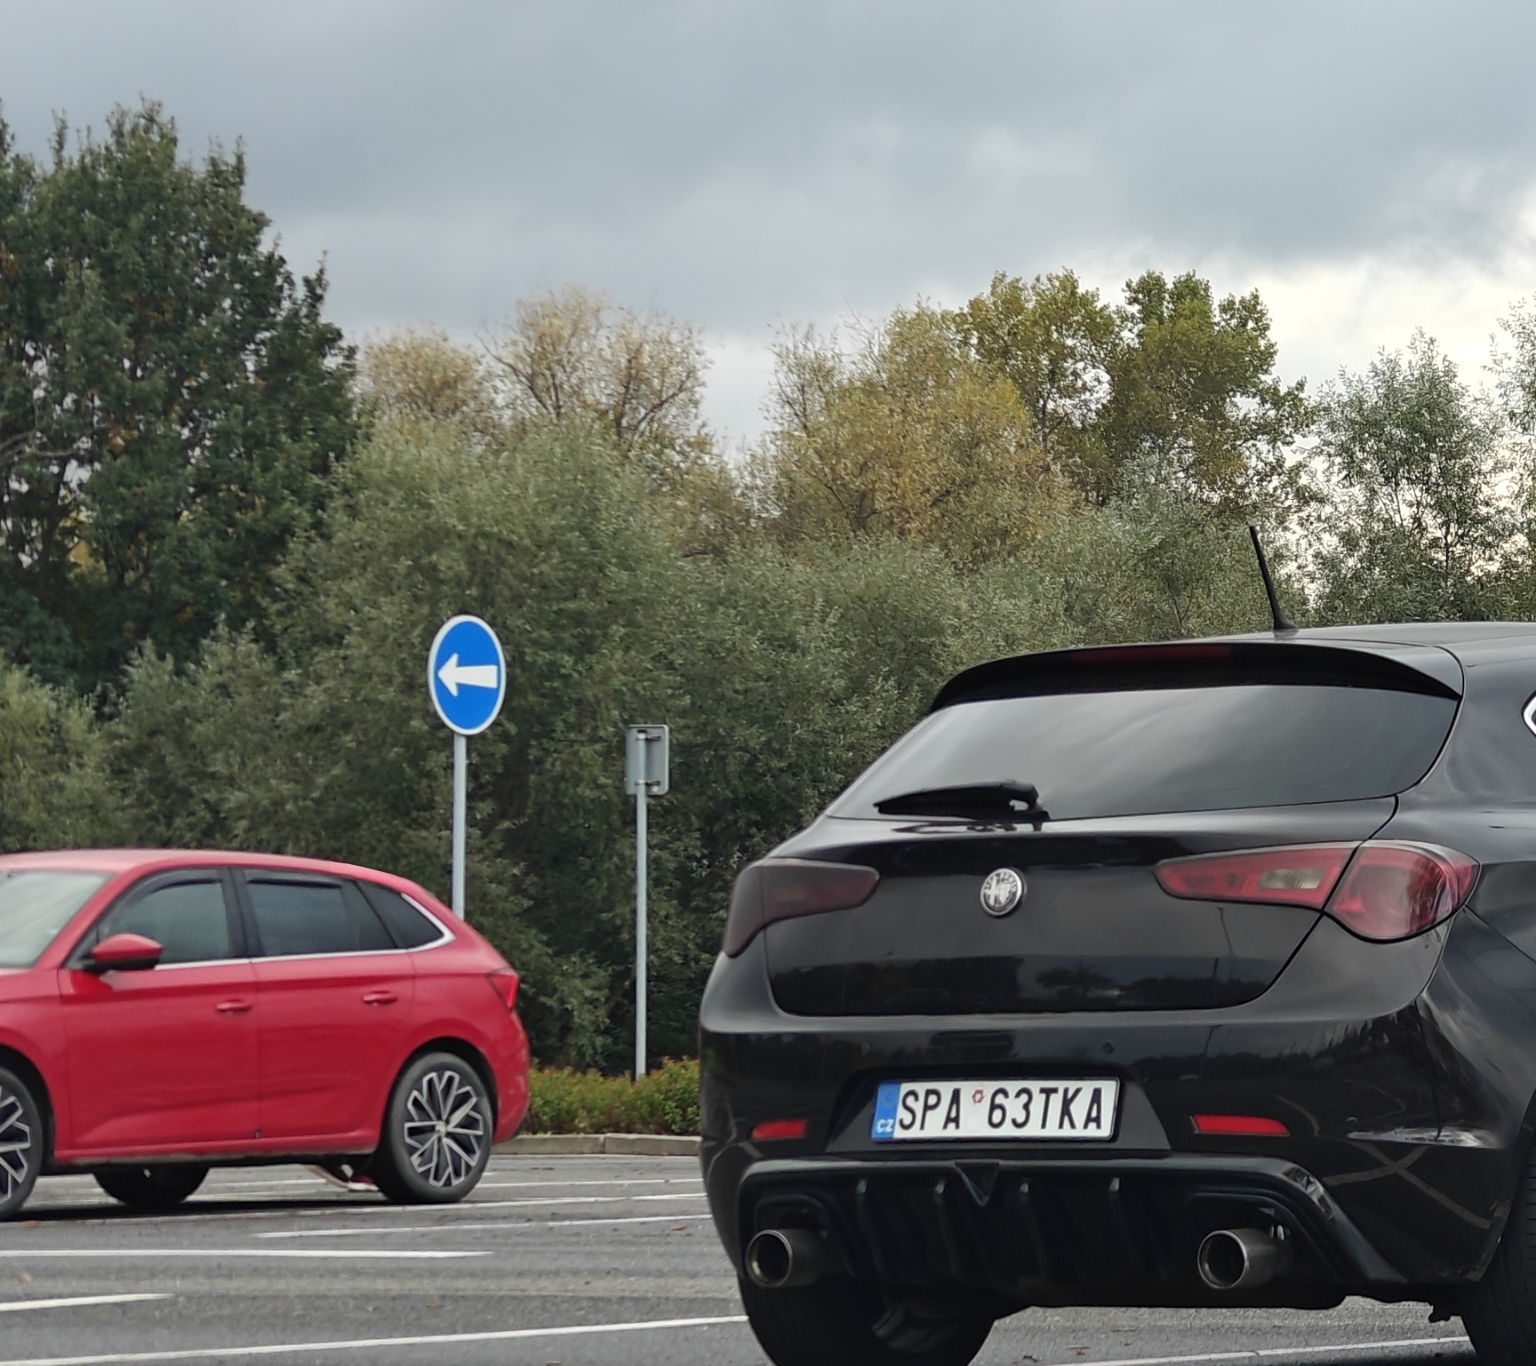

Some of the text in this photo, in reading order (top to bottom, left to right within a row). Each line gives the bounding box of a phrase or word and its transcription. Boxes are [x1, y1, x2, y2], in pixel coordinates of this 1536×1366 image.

[898, 1087, 1103, 1131] SPA 63TKA
[876, 1118, 895, 1133] CZ
